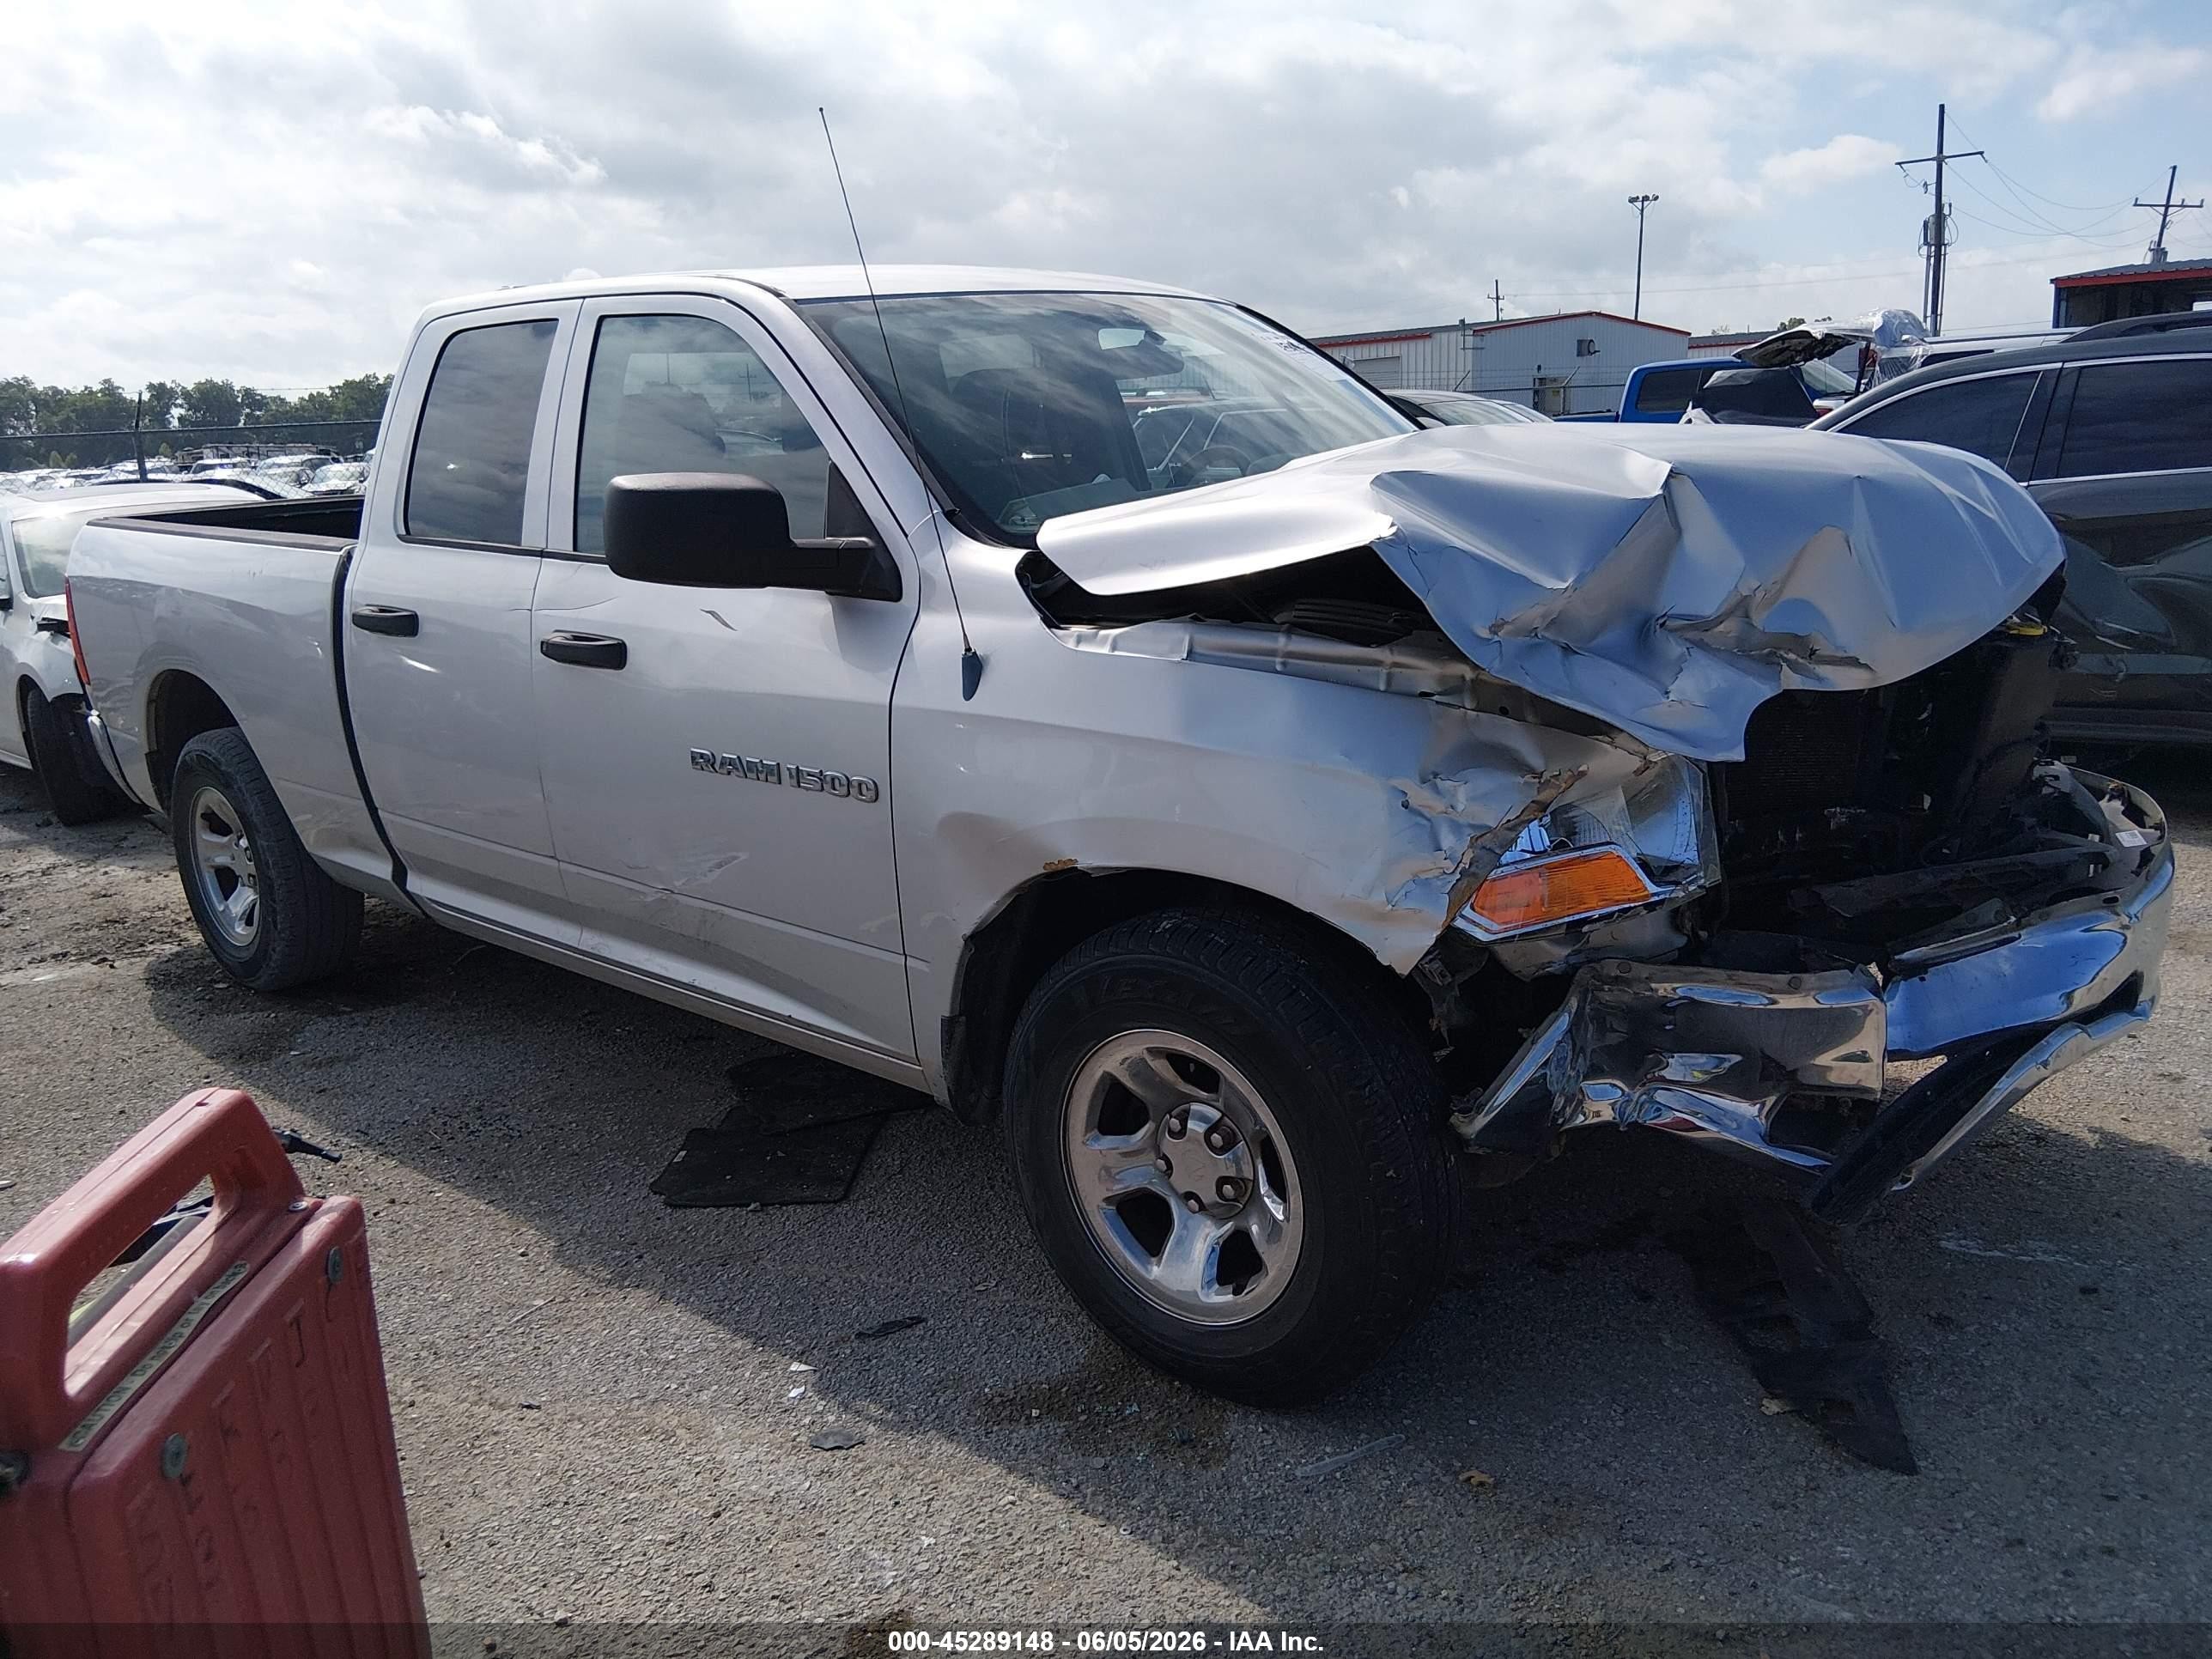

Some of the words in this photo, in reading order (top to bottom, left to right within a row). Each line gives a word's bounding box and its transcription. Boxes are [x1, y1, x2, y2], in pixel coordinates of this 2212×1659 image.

[690, 747, 781, 785] RAM
[787, 763, 879, 804] 1500
[68, 1386, 131, 1447] CAUTION
[131, 1363, 153, 1376] Do
[179, 1318, 194, 1328] or
